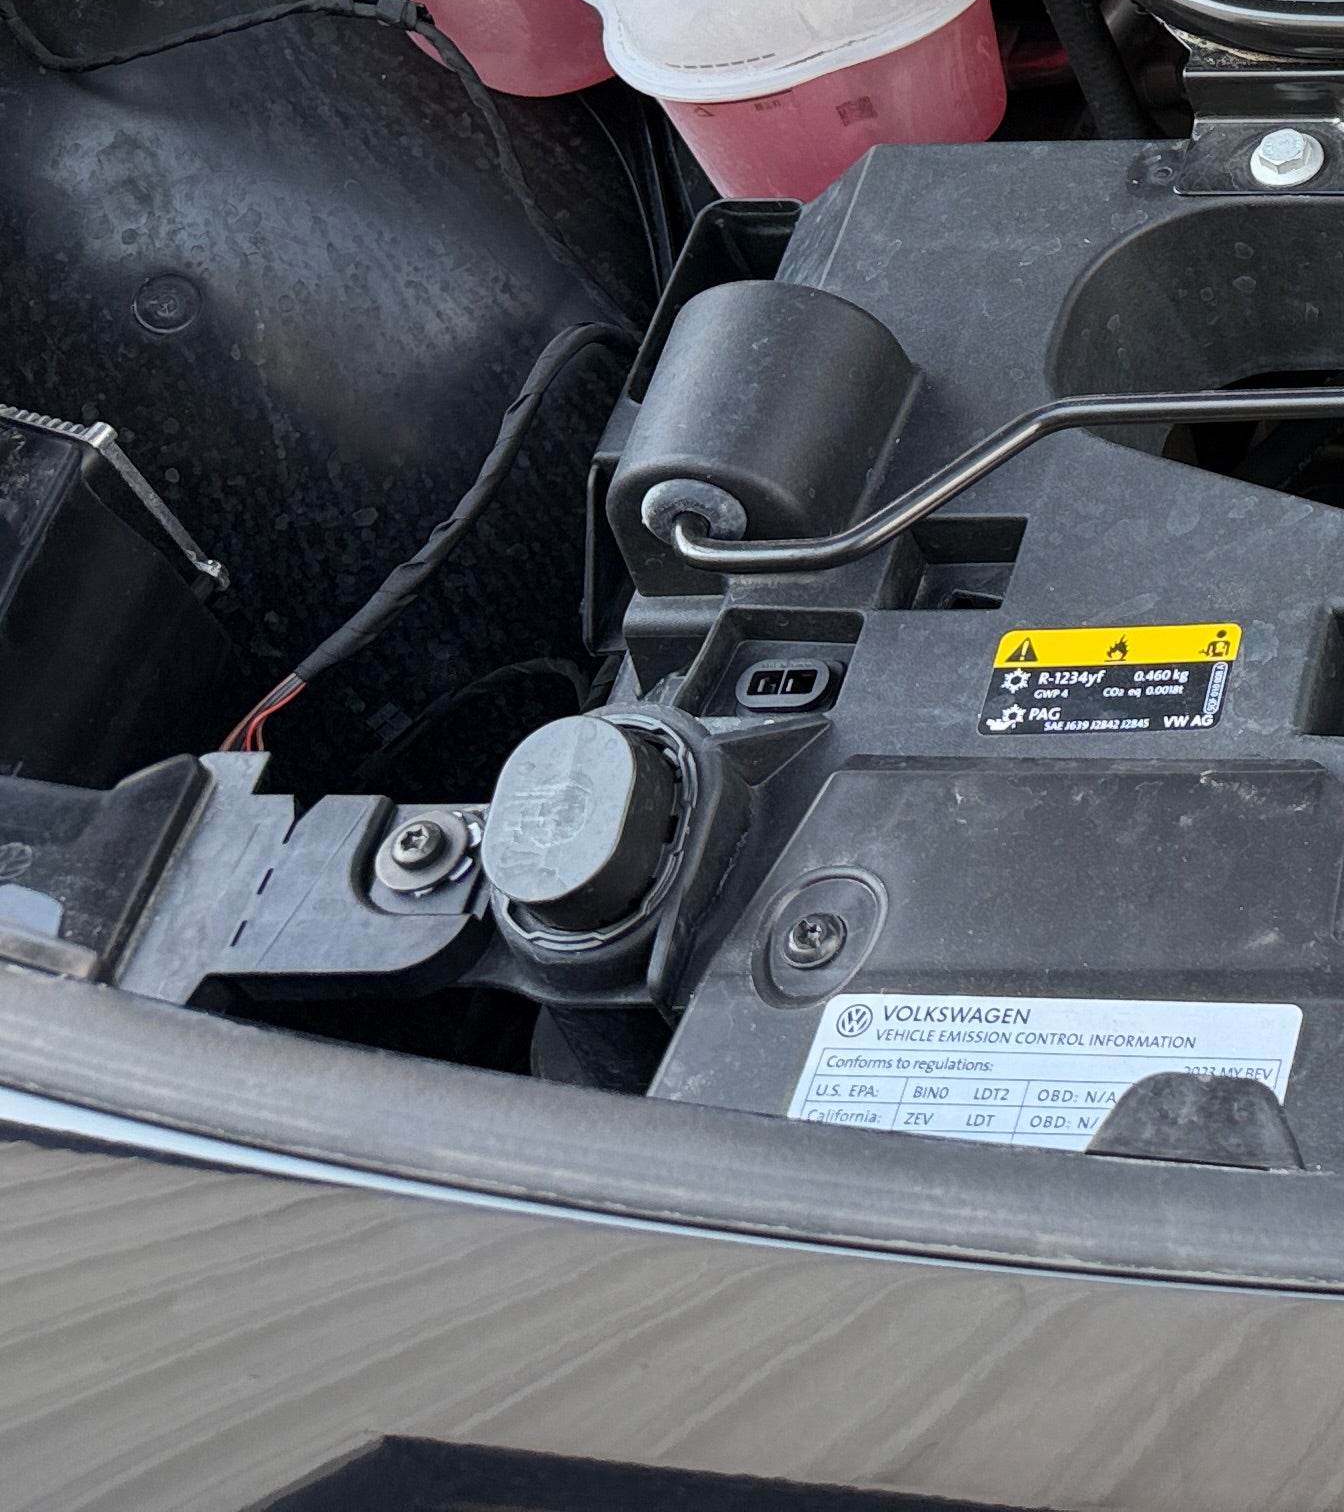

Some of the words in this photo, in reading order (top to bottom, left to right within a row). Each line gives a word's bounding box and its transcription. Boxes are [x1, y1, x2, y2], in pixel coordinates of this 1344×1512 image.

[1038, 669, 1106, 688] R-1234yf
[1133, 669, 1172, 683] 0.460
[1172, 668, 1190, 684] kg
[1033, 689, 1060, 699] GWP
[1061, 688, 1069, 699] 4
[1127, 688, 1142, 699] eq
[1028, 707, 1062, 721] PAG
[1163, 715, 1188, 729] VW
[1190, 714, 1214, 727] AG
[1044, 720, 1064, 731] SAE
[1064, 720, 1089, 731] J639
[883, 1005, 1031, 1025] VOLKSWAGEN
[876, 1028, 936, 1042] VEHICLE
[938, 1029, 1012, 1044] EMISSION
[1015, 1031, 1084, 1046] CONTROL
[1089, 1034, 1197, 1049] INFORMATION
[826, 1055, 893, 1069] Conforms
[896, 1056, 911, 1069] to
[912, 1056, 994, 1073] regulations:
[815, 1084, 842, 1097] U.S.
[849, 1084, 879, 1098] EPA:
[973, 1087, 1009, 1101] LDT2
[1037, 1089, 1079, 1102] OBD:
[1084, 1090, 1117, 1104] N/A
[903, 1112, 934, 1126] ZEV
[965, 1114, 995, 1127] LDT
[1030, 1115, 1071, 1129] OBD:
[1077, 1116, 1099, 1129] N/
